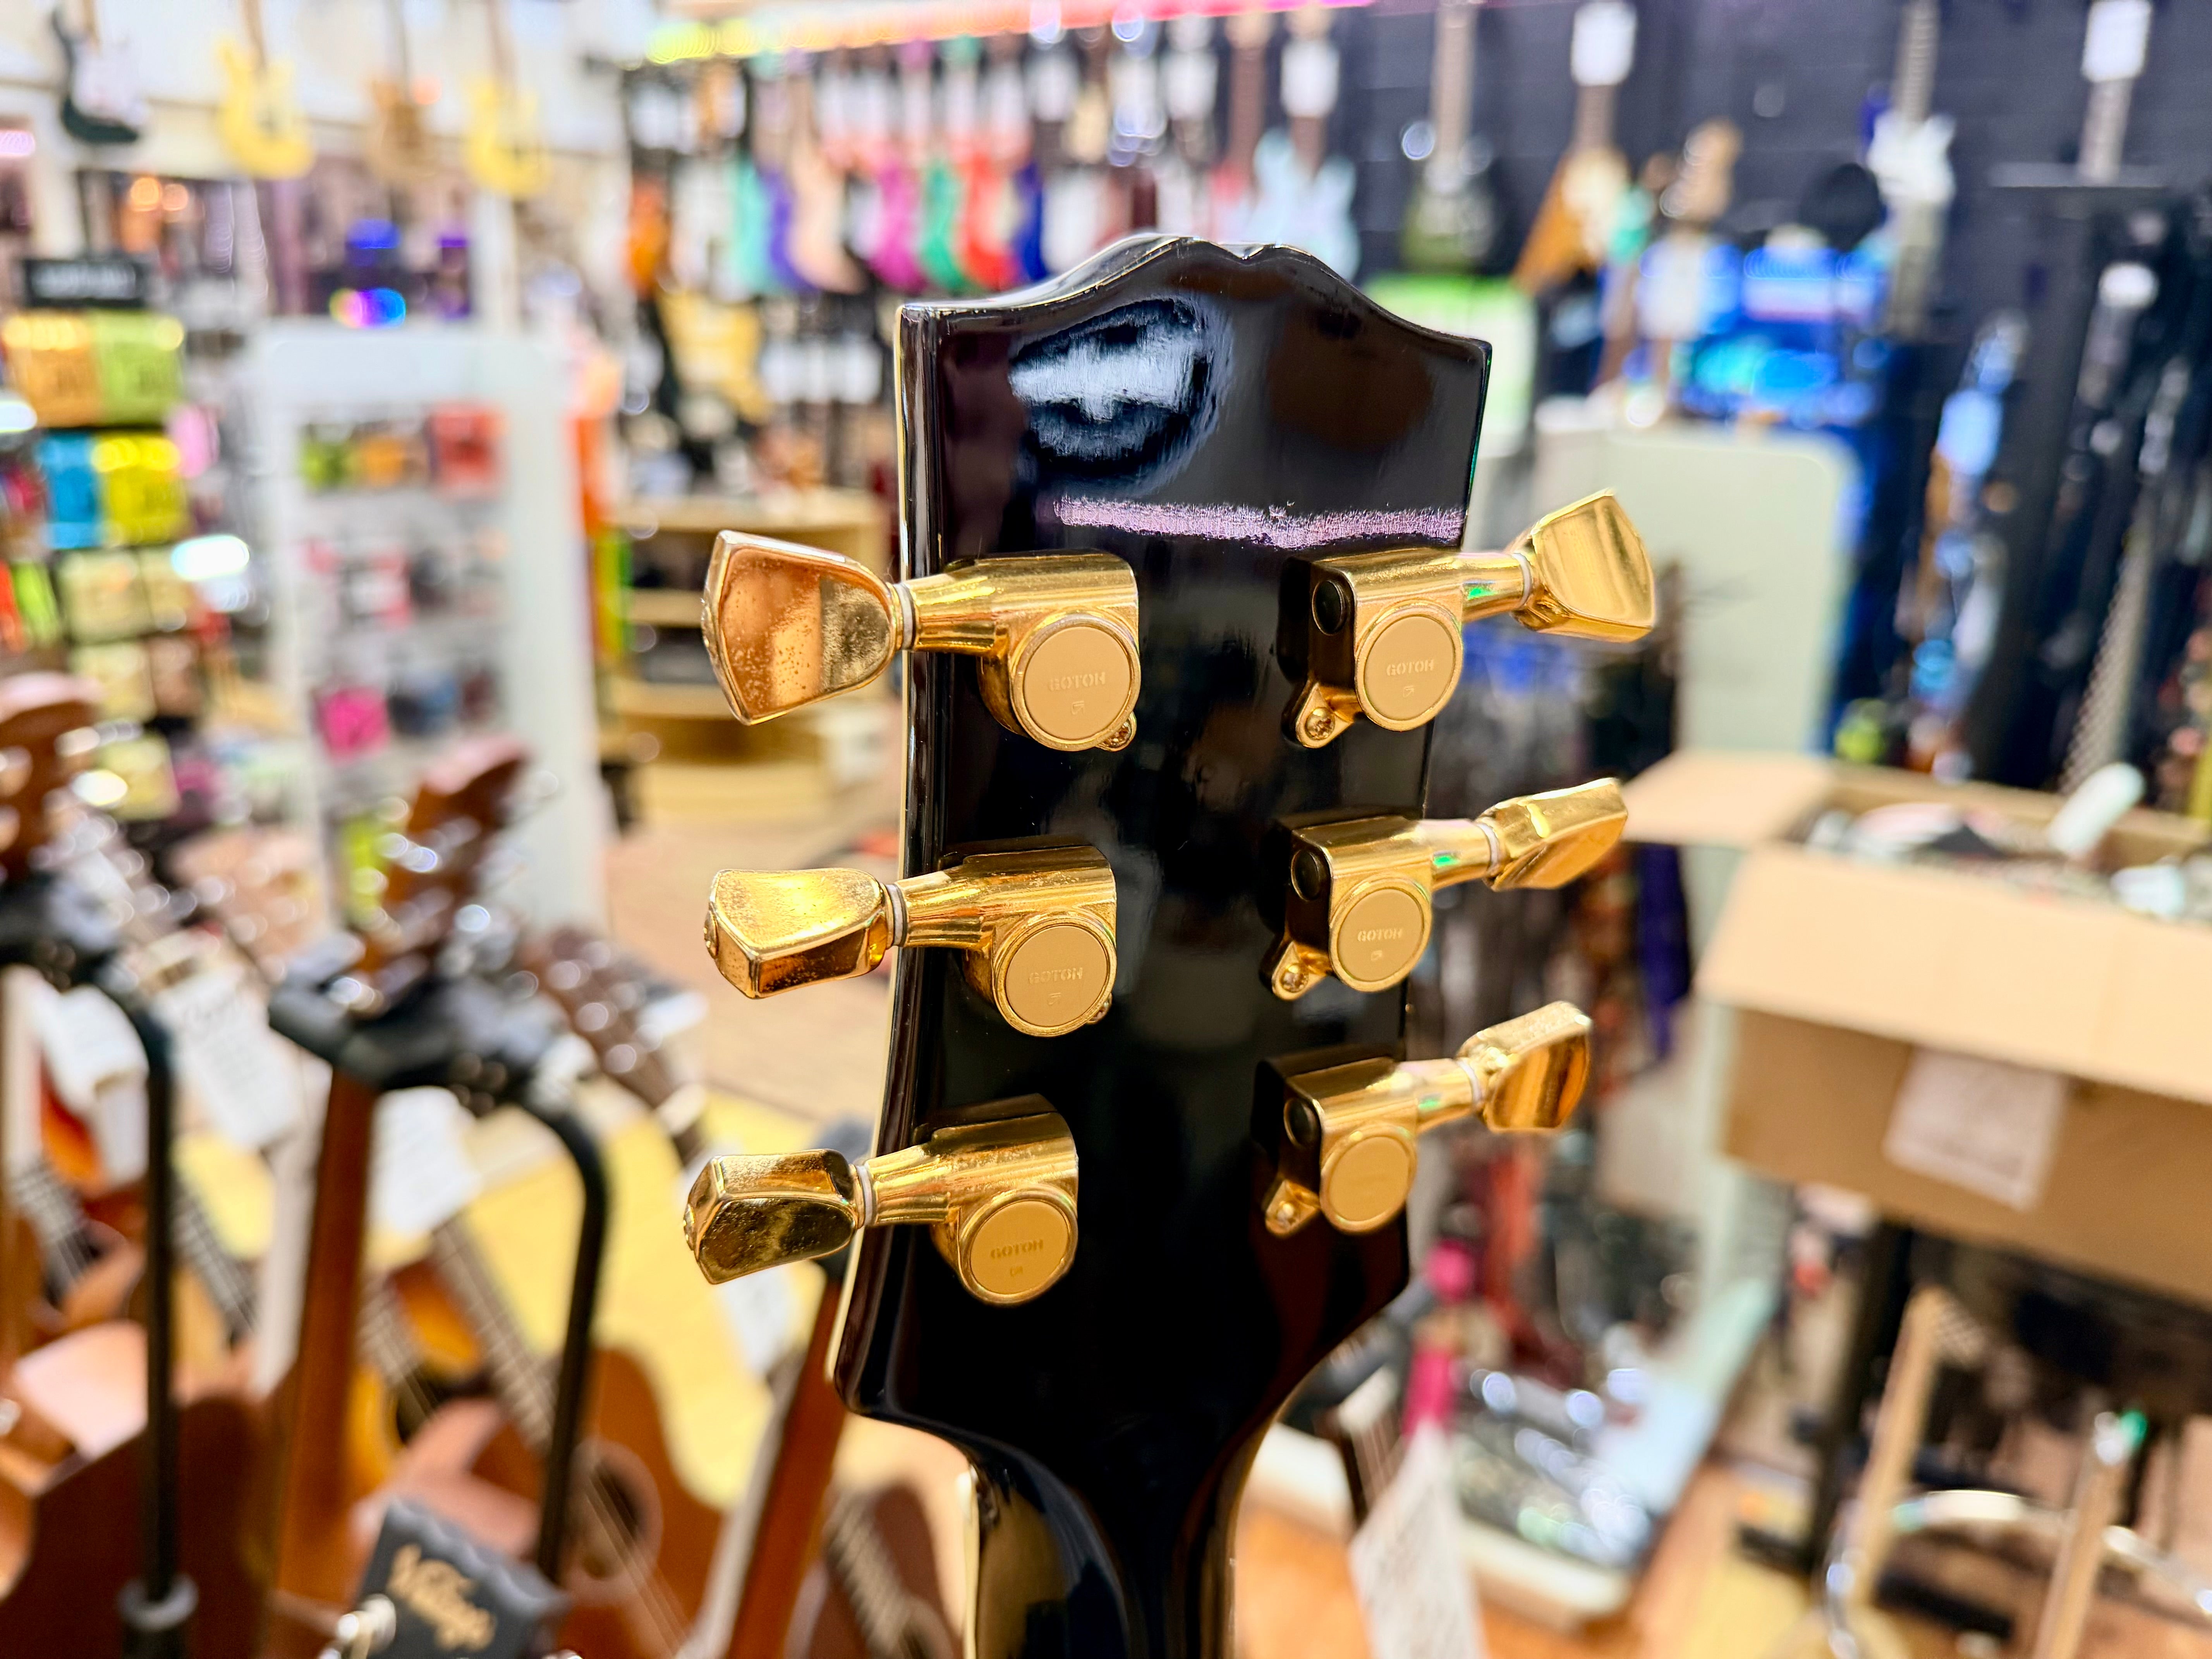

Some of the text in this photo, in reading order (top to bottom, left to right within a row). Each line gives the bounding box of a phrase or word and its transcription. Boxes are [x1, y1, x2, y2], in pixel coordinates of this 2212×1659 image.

[1386, 659, 1434, 676] GOTOH
[1048, 672, 1105, 691] GOTOH
[1357, 929, 1403, 942] GOTOH
[1029, 967, 1083, 984] GOTOH
[990, 1239, 1043, 1259] GOTOH
